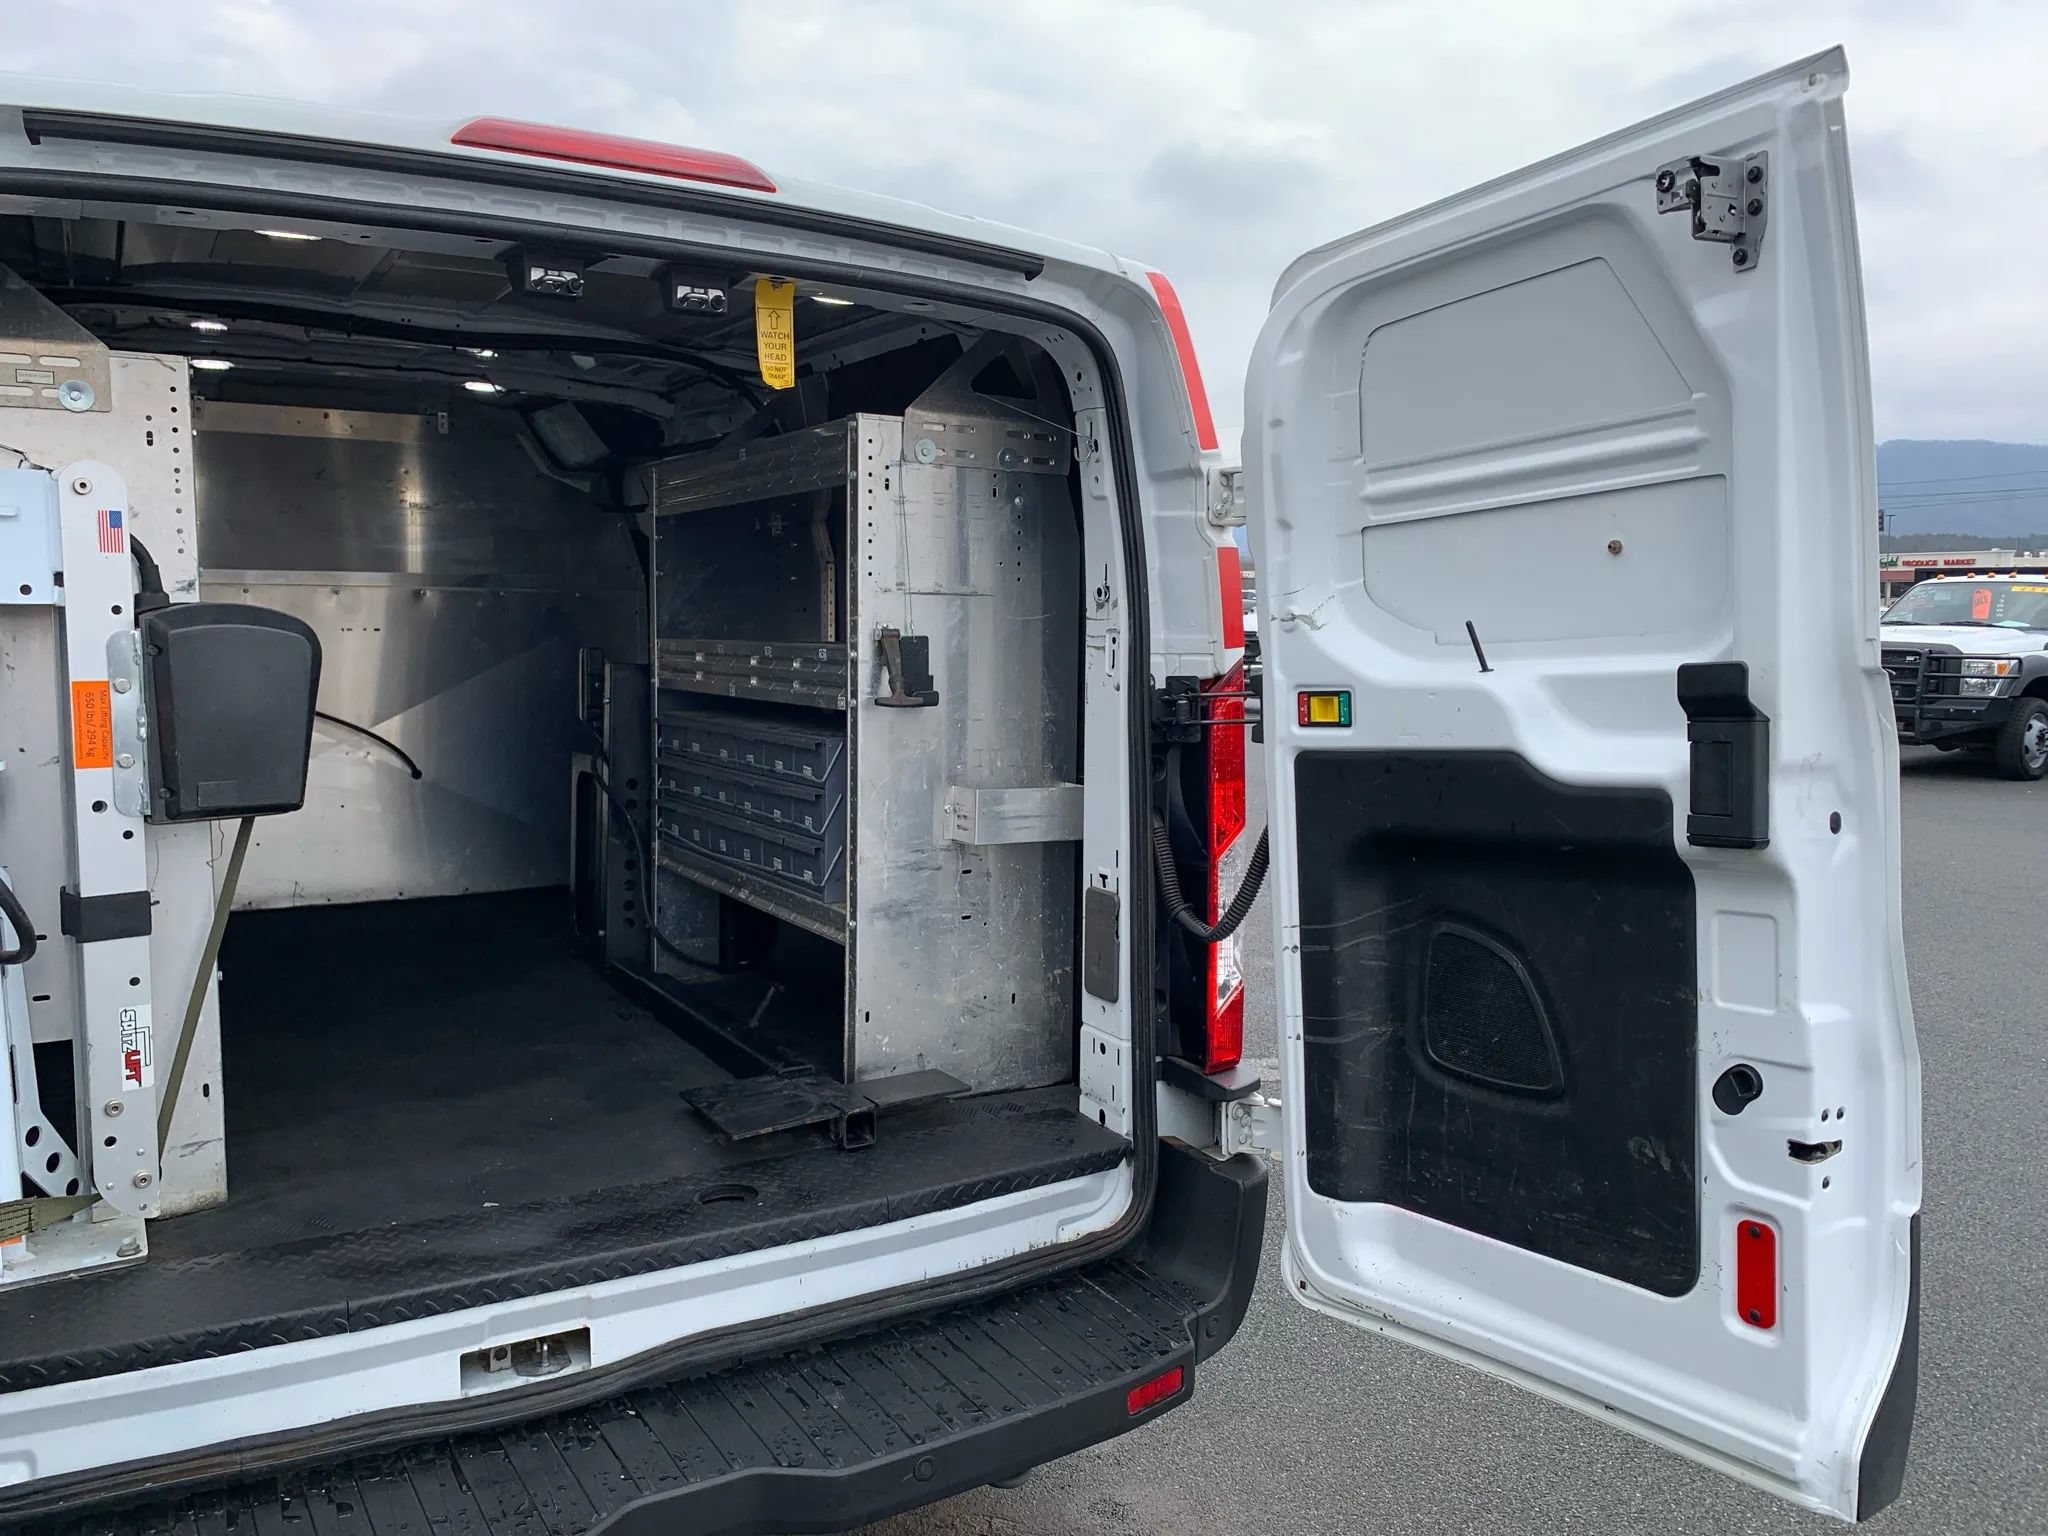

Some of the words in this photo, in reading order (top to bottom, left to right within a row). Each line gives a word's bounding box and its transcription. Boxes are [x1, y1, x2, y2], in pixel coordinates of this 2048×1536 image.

[761, 331, 790, 340] WATCH
[764, 342, 787, 351] YOUR
[764, 353, 787, 361] HEAD
[1943, 558, 1977, 566] MARKET
[85, 692, 95, 708] 650
[100, 689, 108, 705] Max
[100, 707, 108, 729] Lifting
[87, 729, 97, 745] 294
[86, 747, 97, 758] kg
